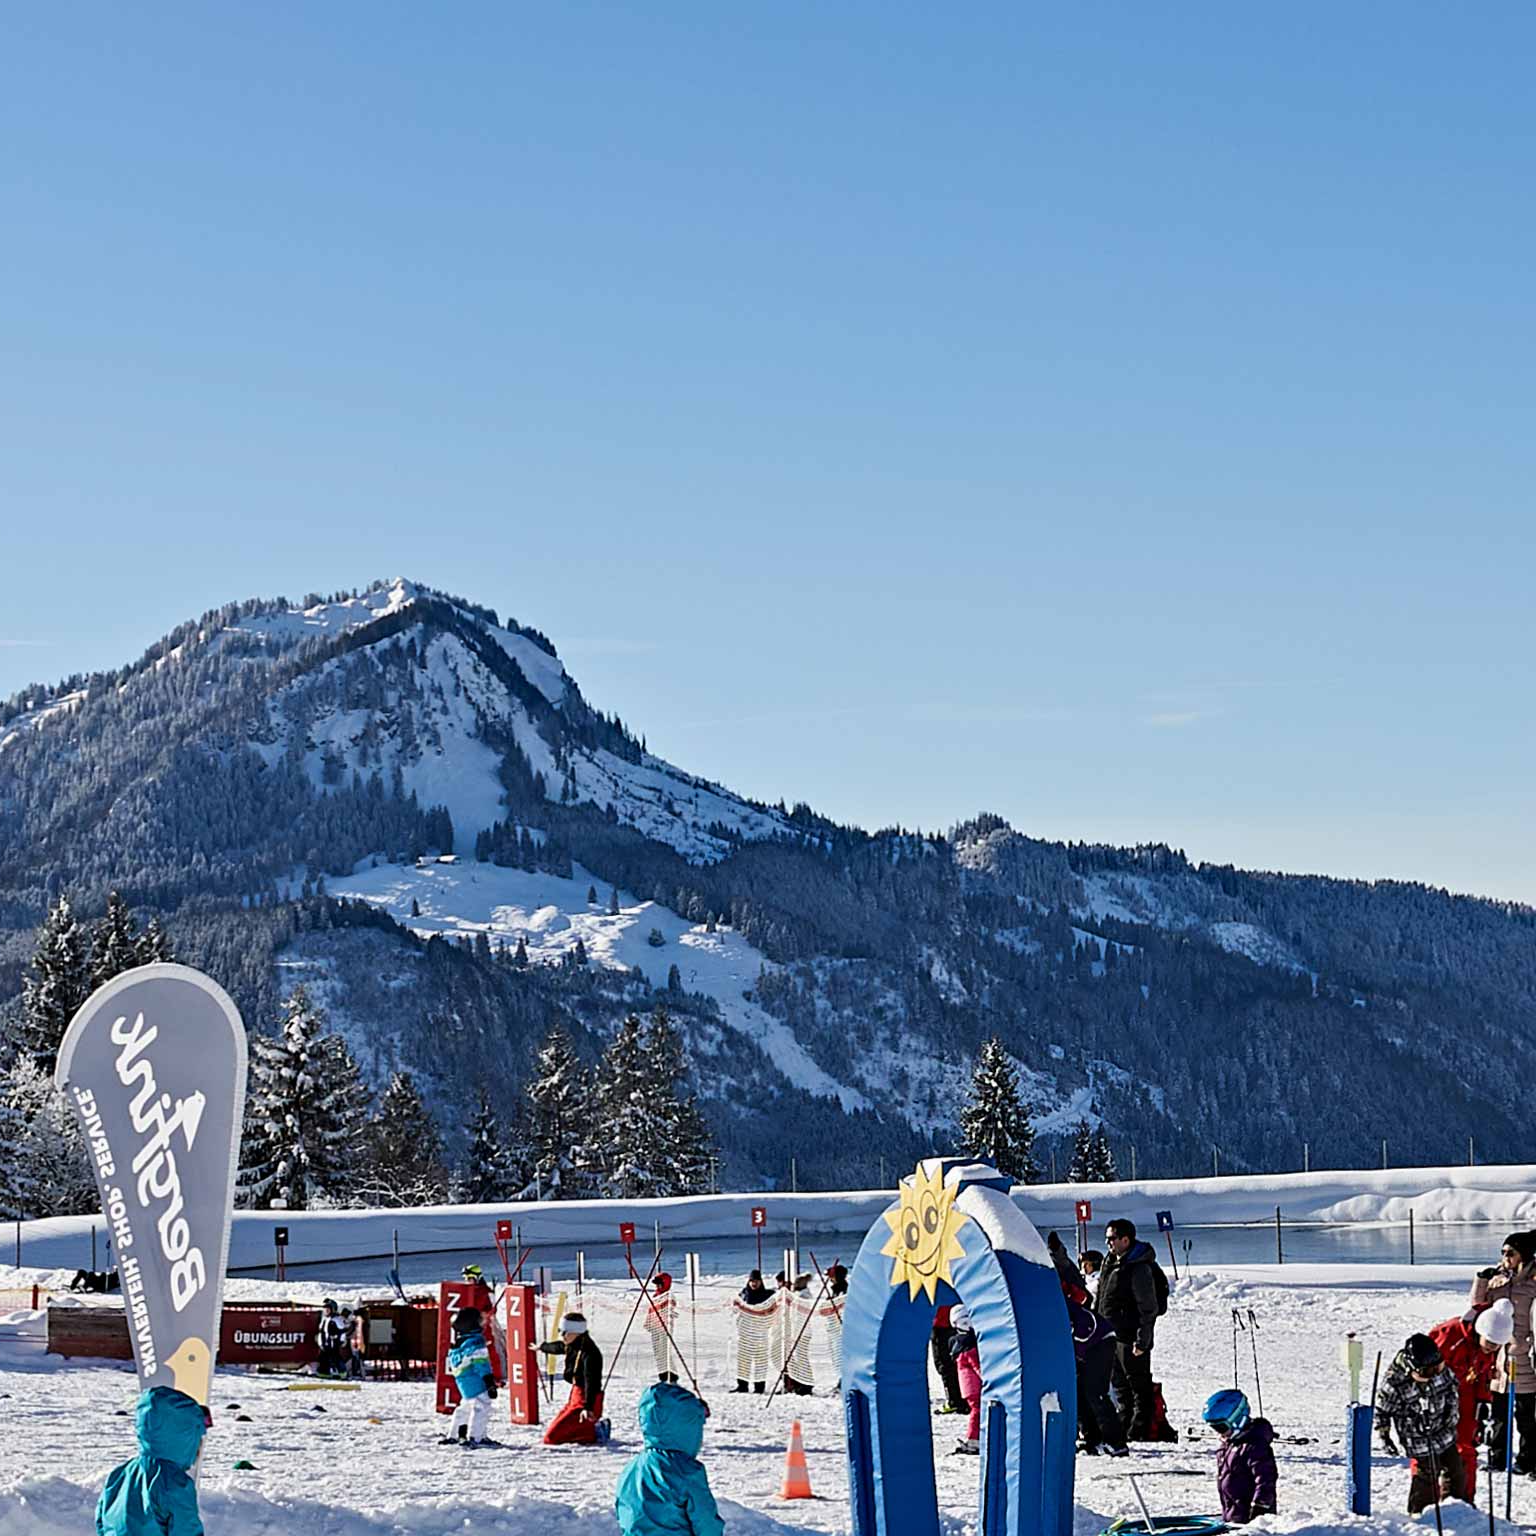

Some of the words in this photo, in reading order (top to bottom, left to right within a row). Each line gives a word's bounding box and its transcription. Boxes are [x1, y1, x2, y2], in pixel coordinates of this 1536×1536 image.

[754, 1210, 763, 1223] 3
[1080, 1204, 1087, 1217] 1
[234, 1329, 306, 1344] ÜBUNGSLIFT
[510, 1296, 525, 1417] ZIEL
